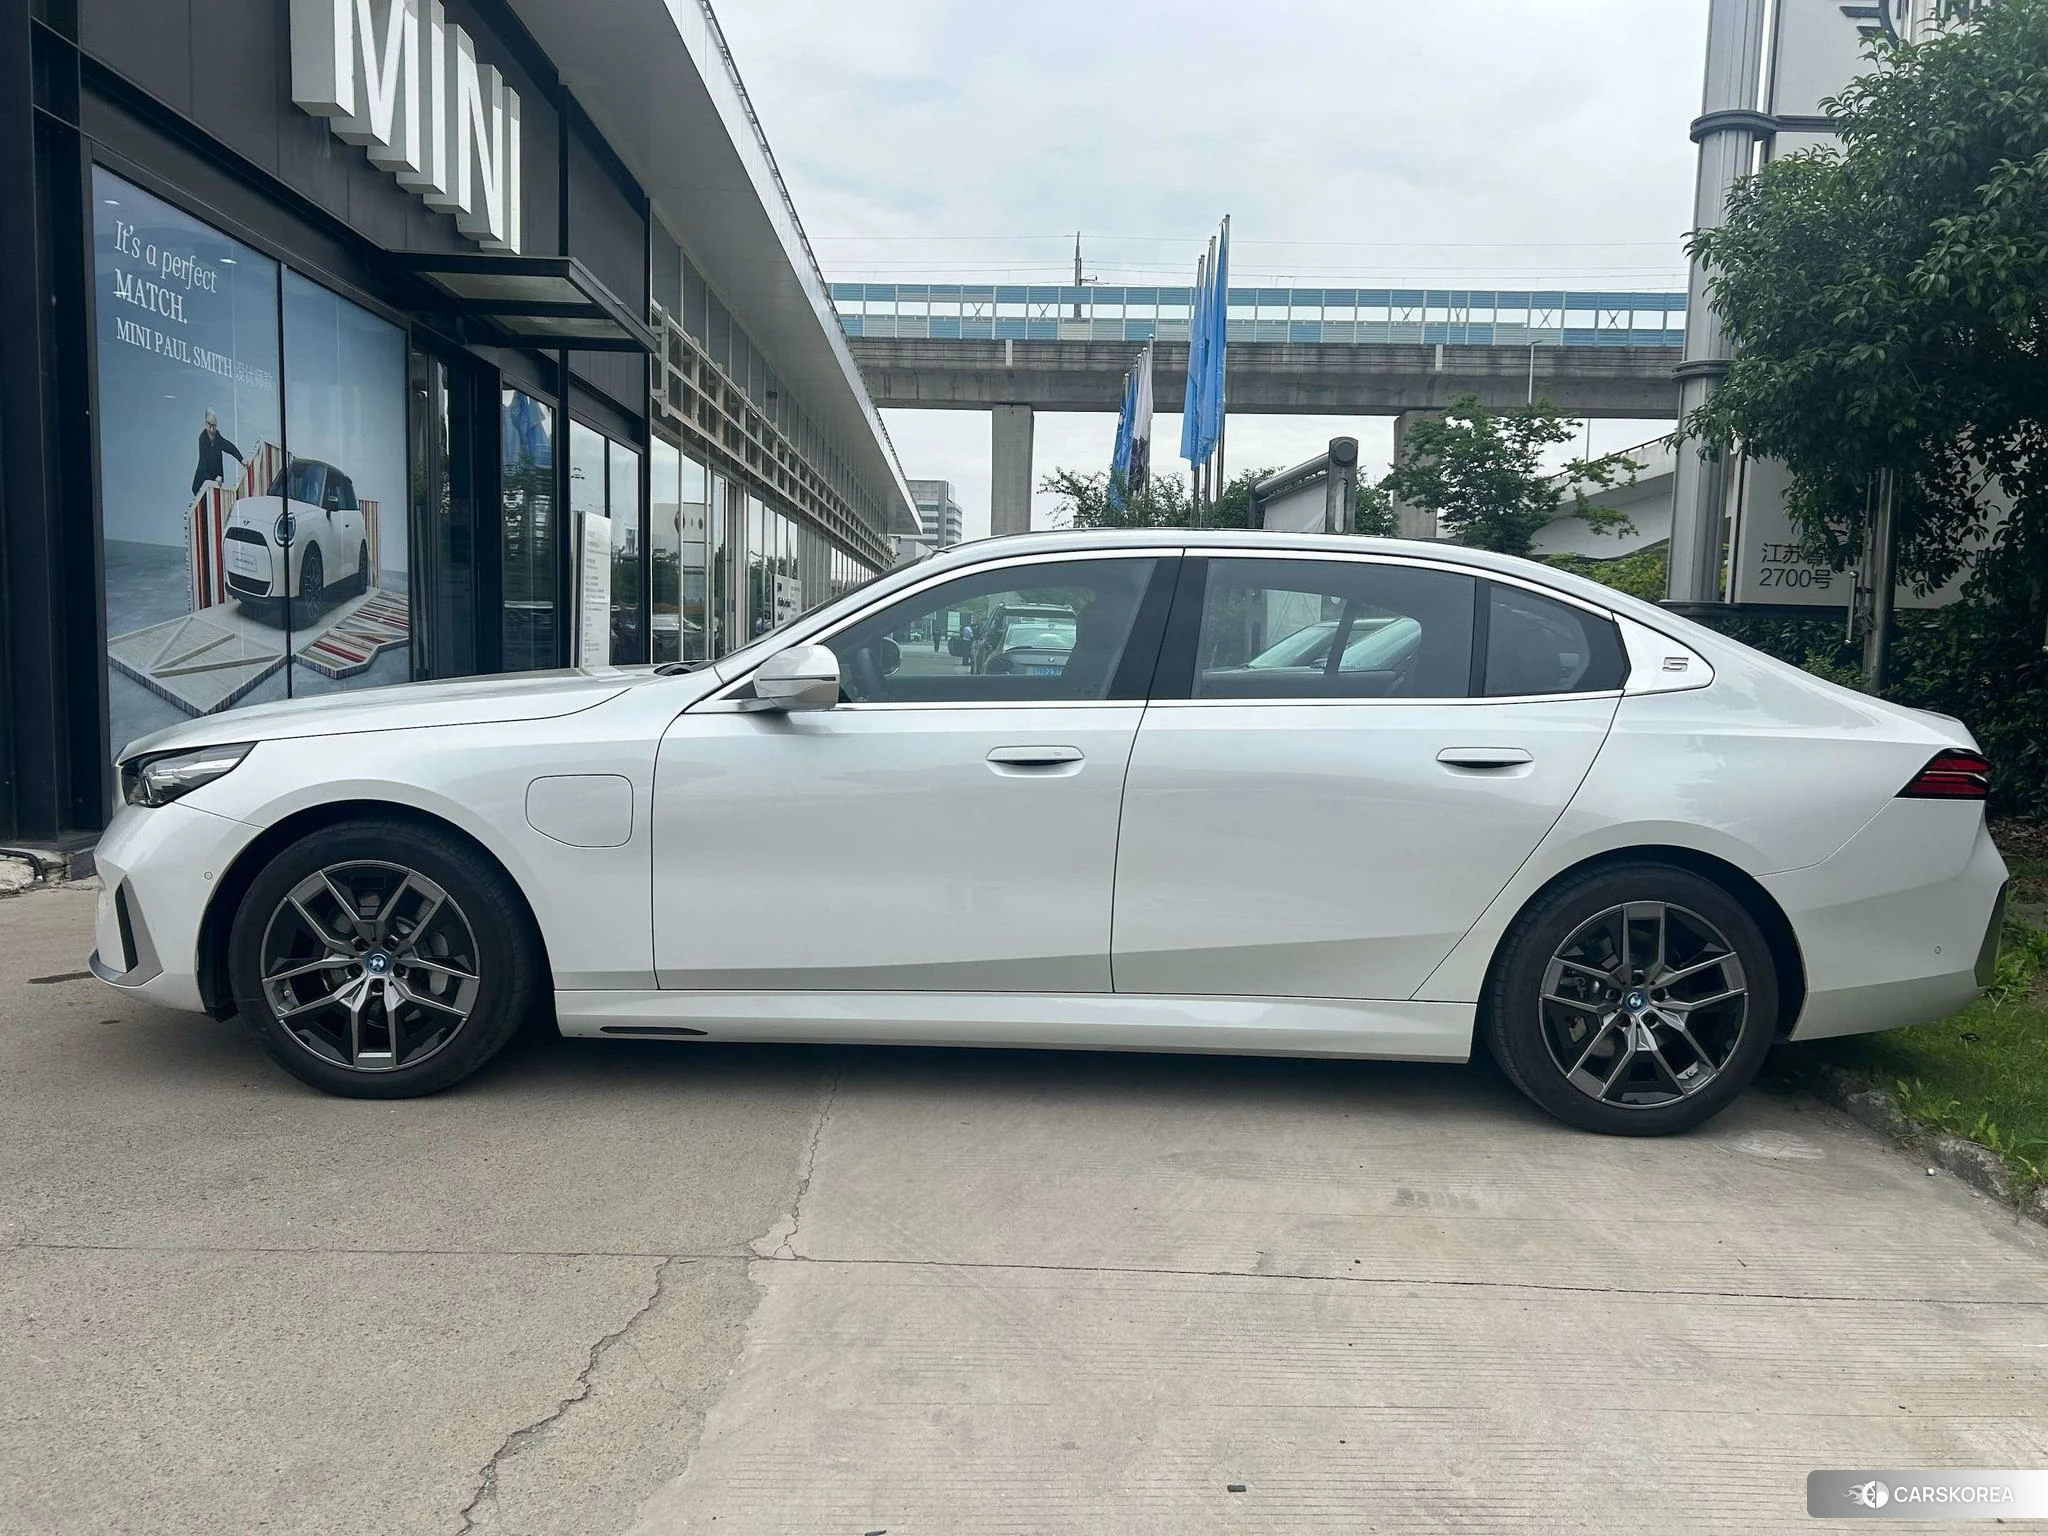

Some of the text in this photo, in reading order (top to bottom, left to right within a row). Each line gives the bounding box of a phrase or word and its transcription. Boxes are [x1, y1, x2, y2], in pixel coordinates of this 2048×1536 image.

[292, 0, 520, 255] MINI
[114, 220, 217, 293] It's a perfect
[115, 268, 188, 324] MATCH.
[116, 317, 151, 350] MINI
[154, 331, 190, 363] PAUL
[193, 346, 233, 378] SMITH
[1759, 568, 1833, 589] 2700号
